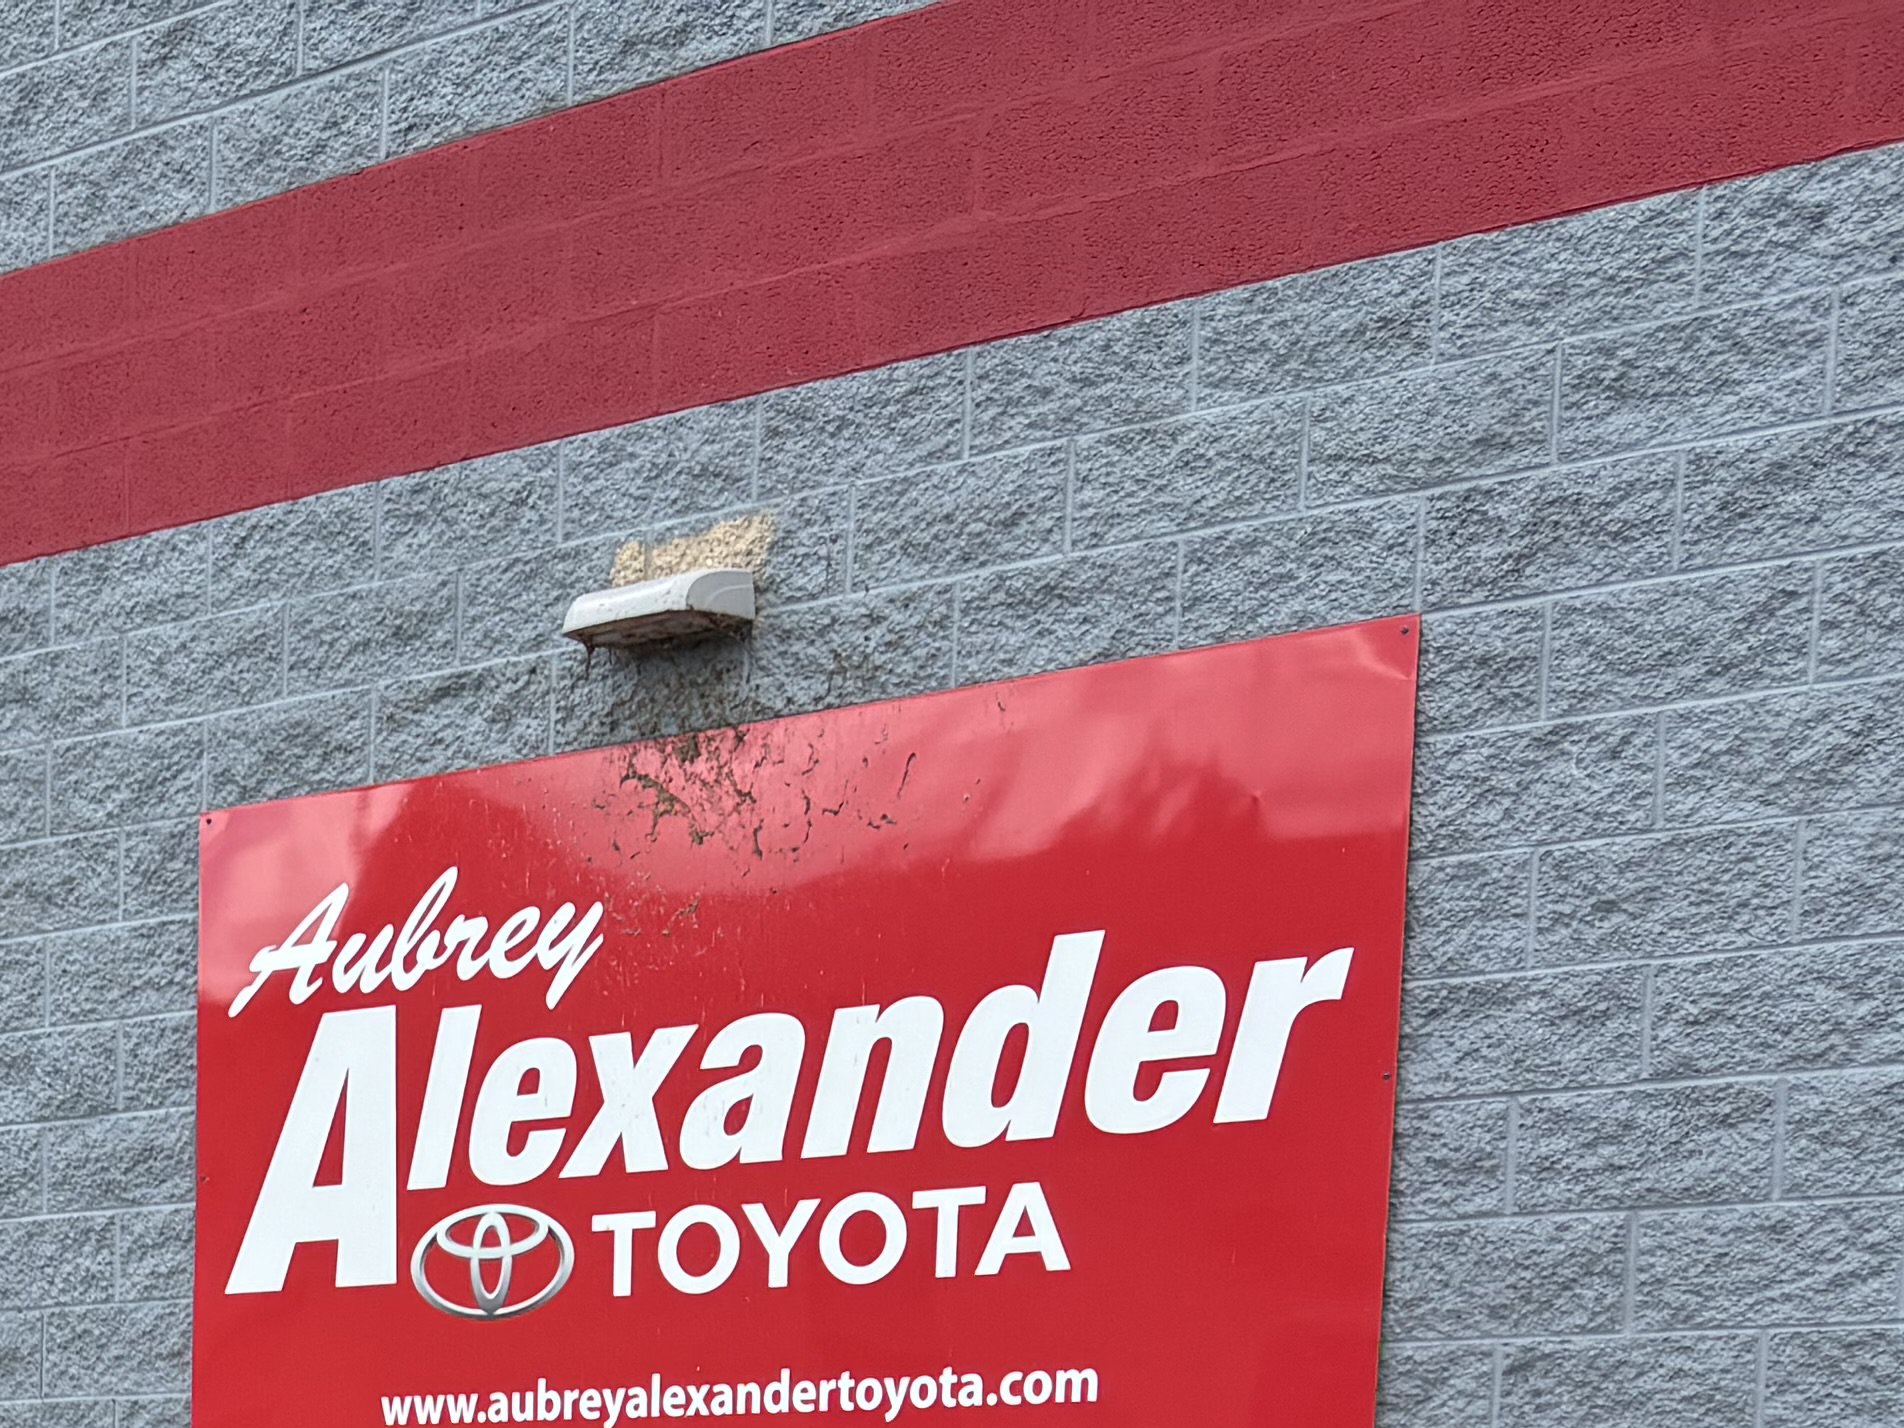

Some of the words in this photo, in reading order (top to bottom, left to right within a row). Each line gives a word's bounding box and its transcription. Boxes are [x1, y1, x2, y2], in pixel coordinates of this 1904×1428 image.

[227, 866, 604, 1018] Aubrey
[224, 929, 1355, 1295] Alexander
[591, 1182, 1071, 1297] TOYOTA
